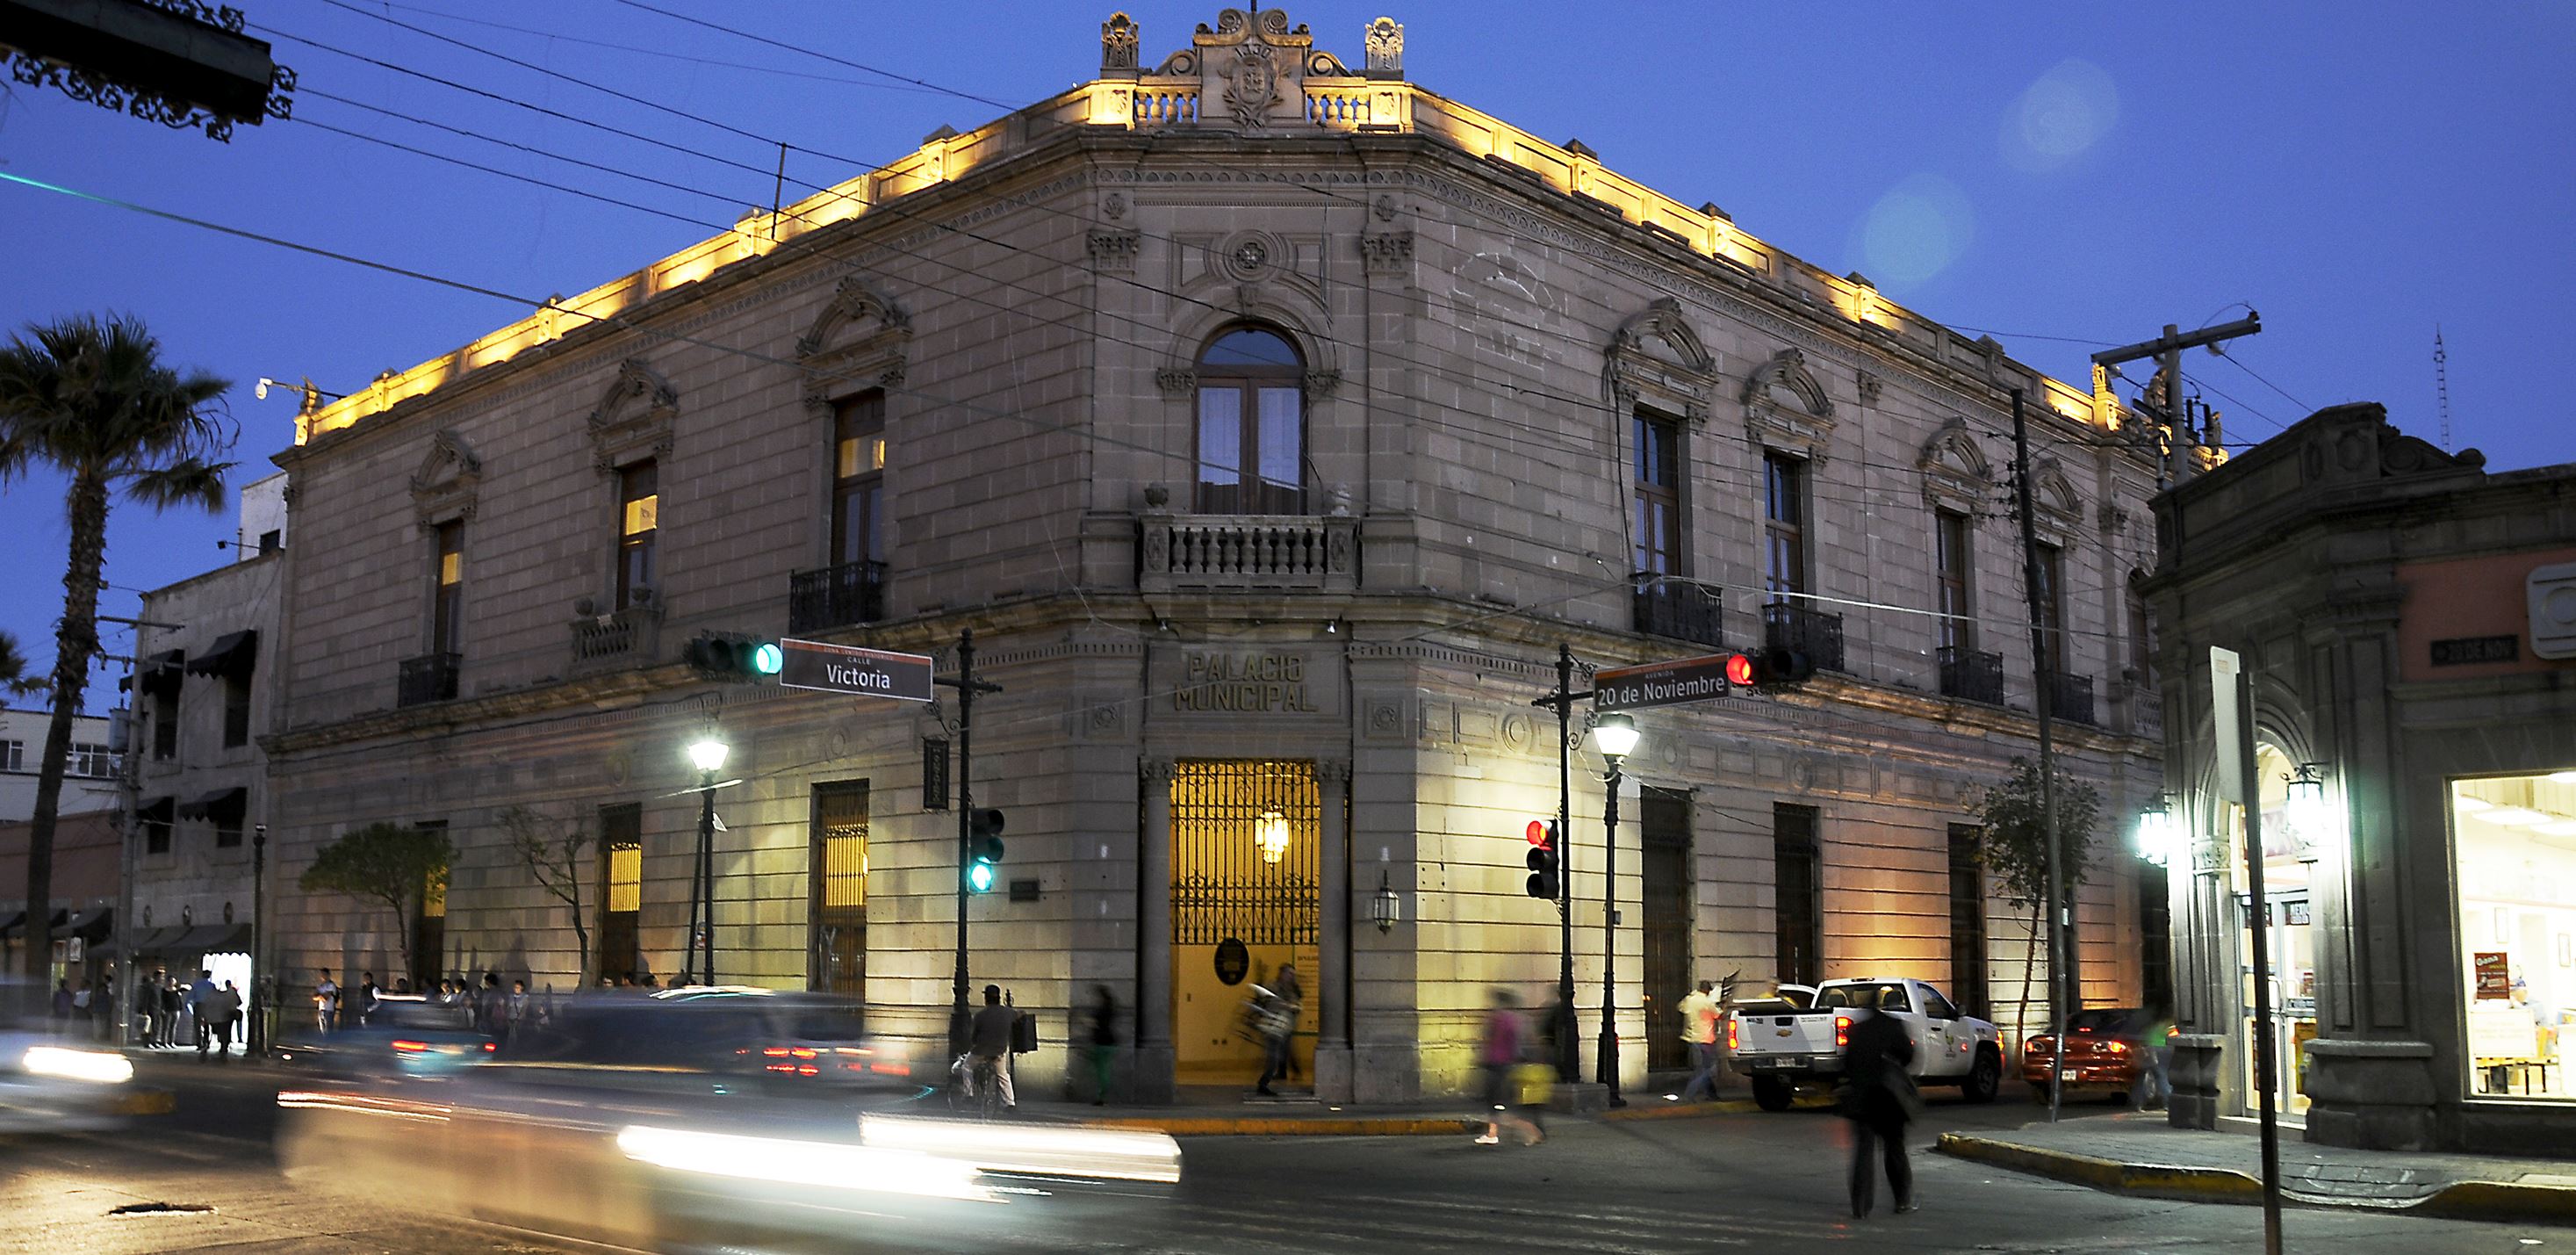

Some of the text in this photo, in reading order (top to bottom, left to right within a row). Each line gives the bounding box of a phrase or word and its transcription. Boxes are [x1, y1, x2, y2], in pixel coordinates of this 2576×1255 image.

[846, 656, 871, 665] CALLE
[1188, 653, 1305, 682] PALACIO
[826, 663, 891, 689] Victoria
[1644, 670, 1674, 680] AVENIDA
[1173, 682, 1319, 712] MUNICIPAL
[1598, 675, 1725, 706] 20 de Noviembre
